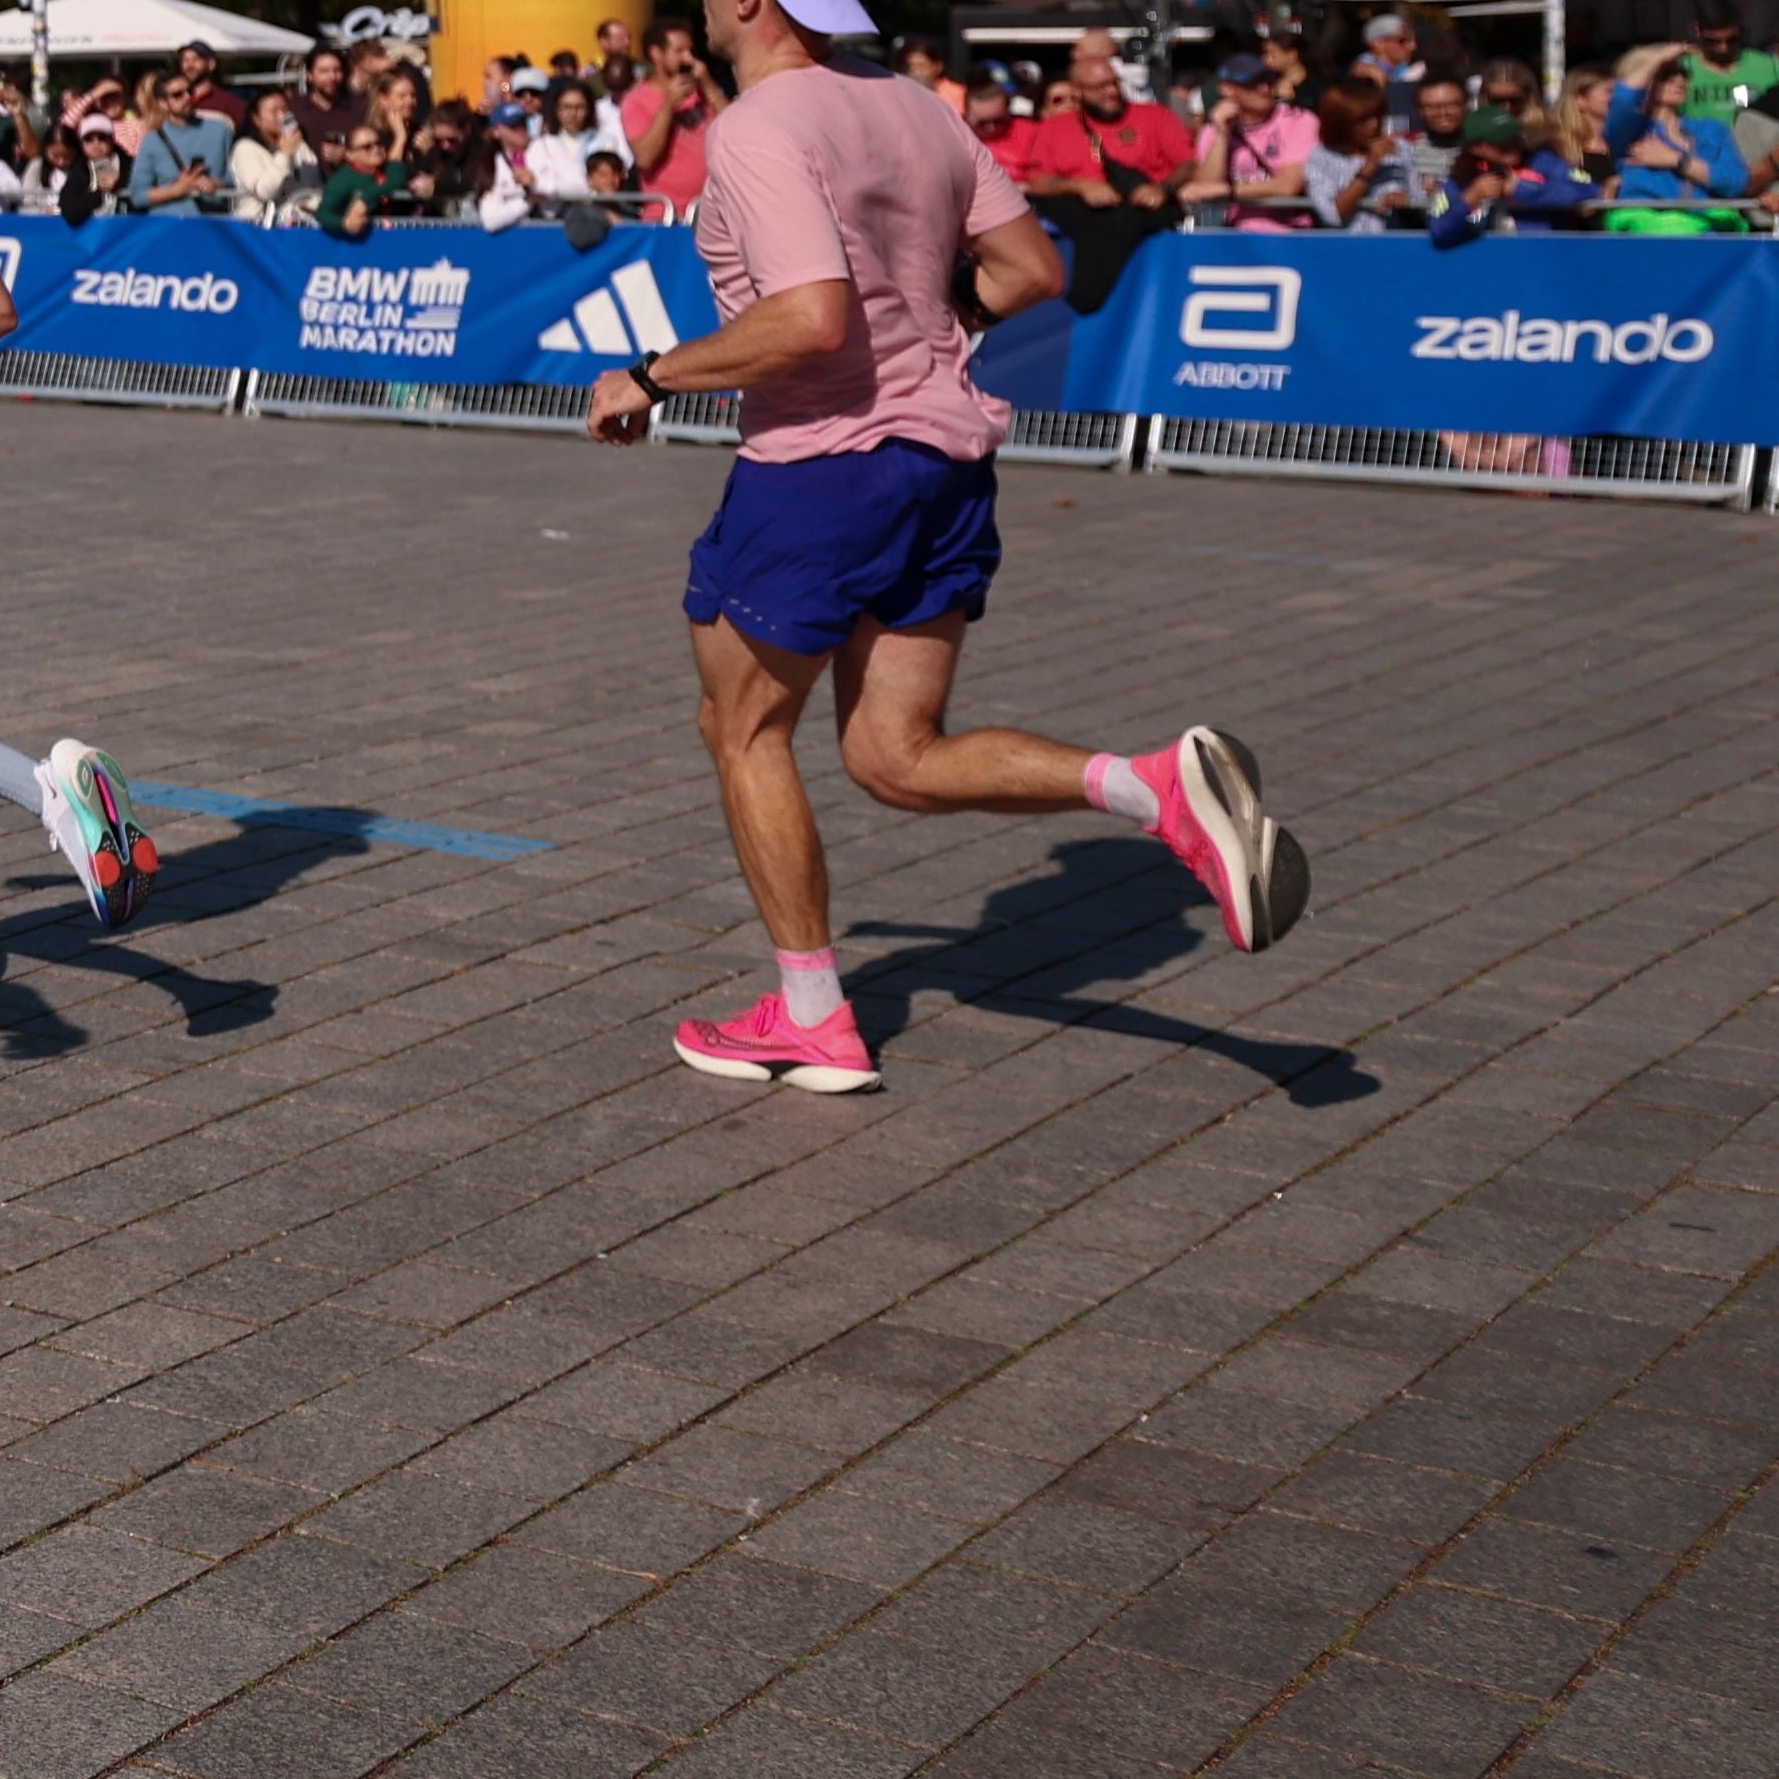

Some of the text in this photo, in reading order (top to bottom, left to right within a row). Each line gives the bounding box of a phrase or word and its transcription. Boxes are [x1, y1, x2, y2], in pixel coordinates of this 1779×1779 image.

[71, 267, 239, 314] zalando
[303, 266, 414, 304] BMW
[299, 298, 404, 329] BERLIN
[299, 325, 457, 357] MARATHON
[1410, 309, 1715, 365] zalando
[1174, 360, 1292, 391] ABBOTT
